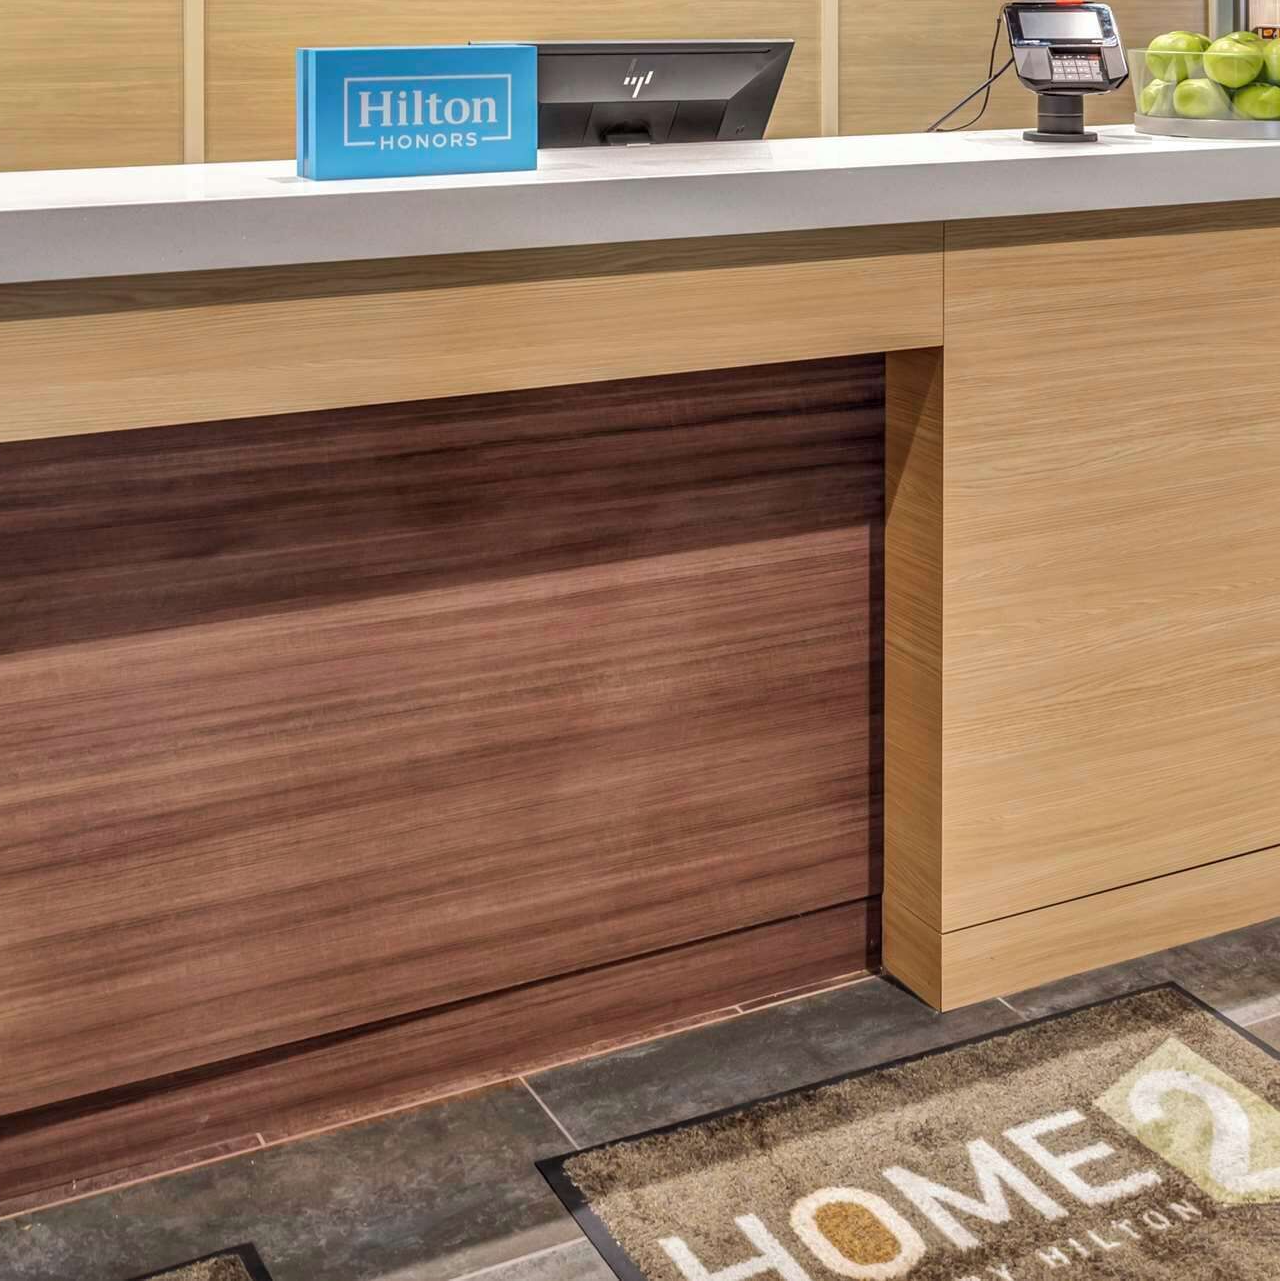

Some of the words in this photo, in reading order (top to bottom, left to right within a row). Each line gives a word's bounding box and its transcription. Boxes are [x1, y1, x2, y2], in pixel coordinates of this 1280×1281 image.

[358, 89, 498, 128] Hilton
[379, 131, 478, 151] HONORS
[657, 1110, 1163, 1281] HOME
[1034, 1199, 1204, 1269] HILTON
